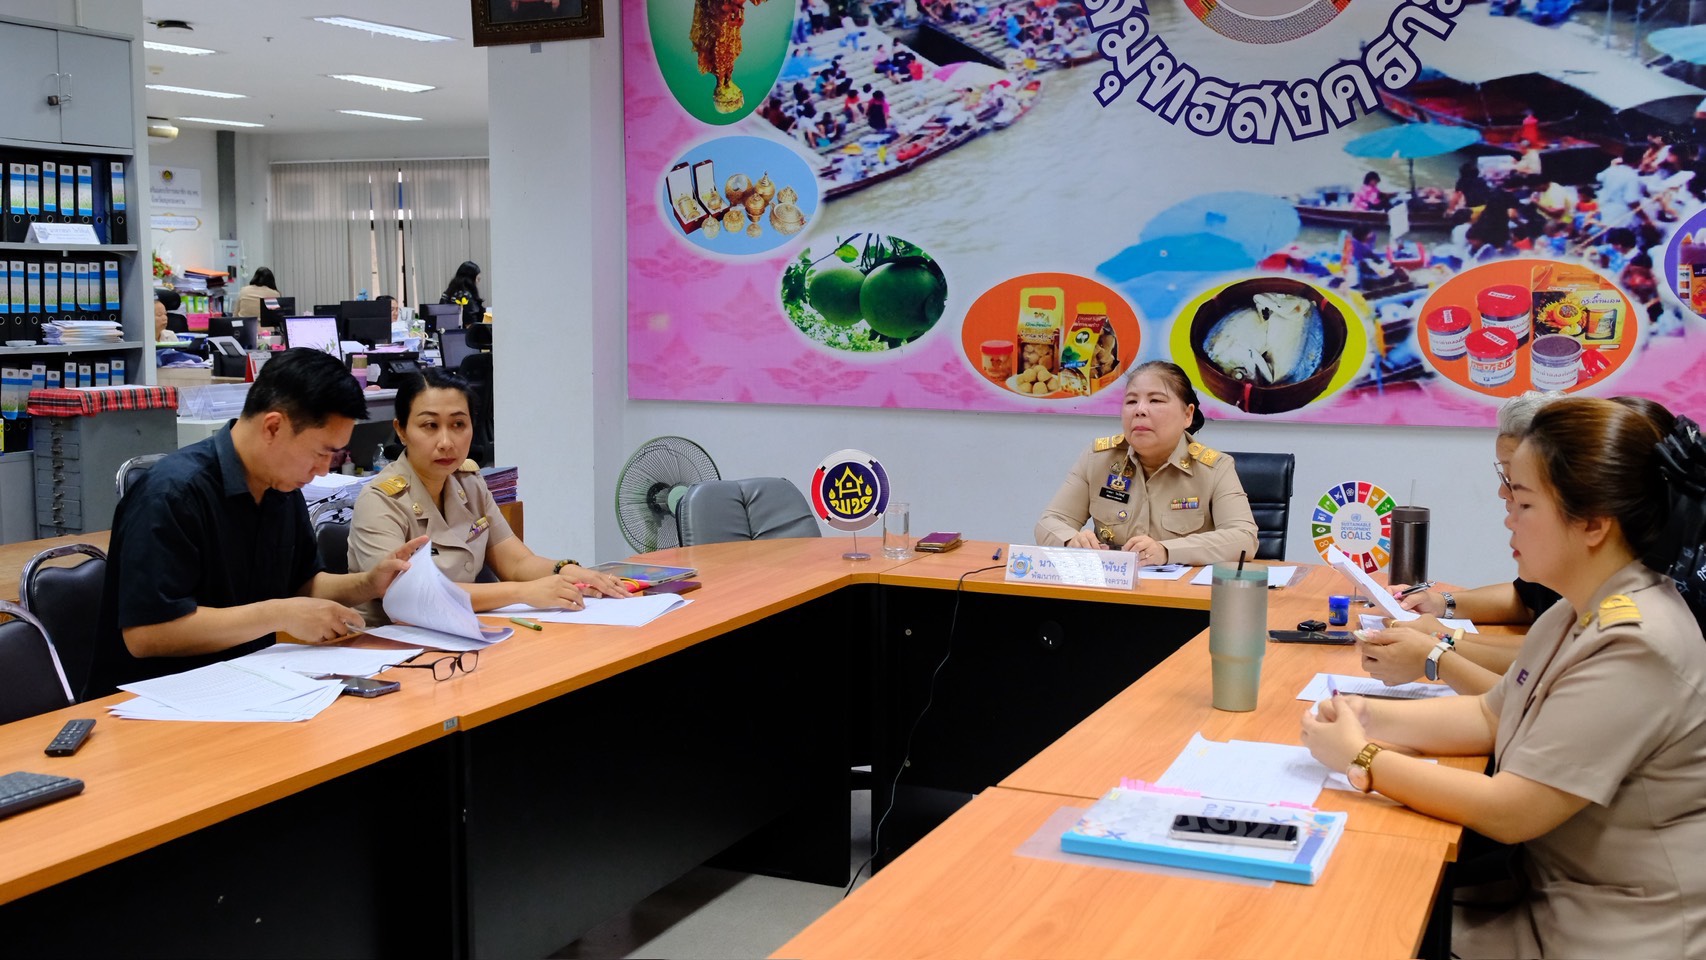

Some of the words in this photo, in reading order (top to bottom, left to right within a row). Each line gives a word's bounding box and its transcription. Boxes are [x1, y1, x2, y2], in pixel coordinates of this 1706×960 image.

[1083, 0, 1467, 145] สมุทรสงครา
[1341, 531, 1371, 540] GOALS
